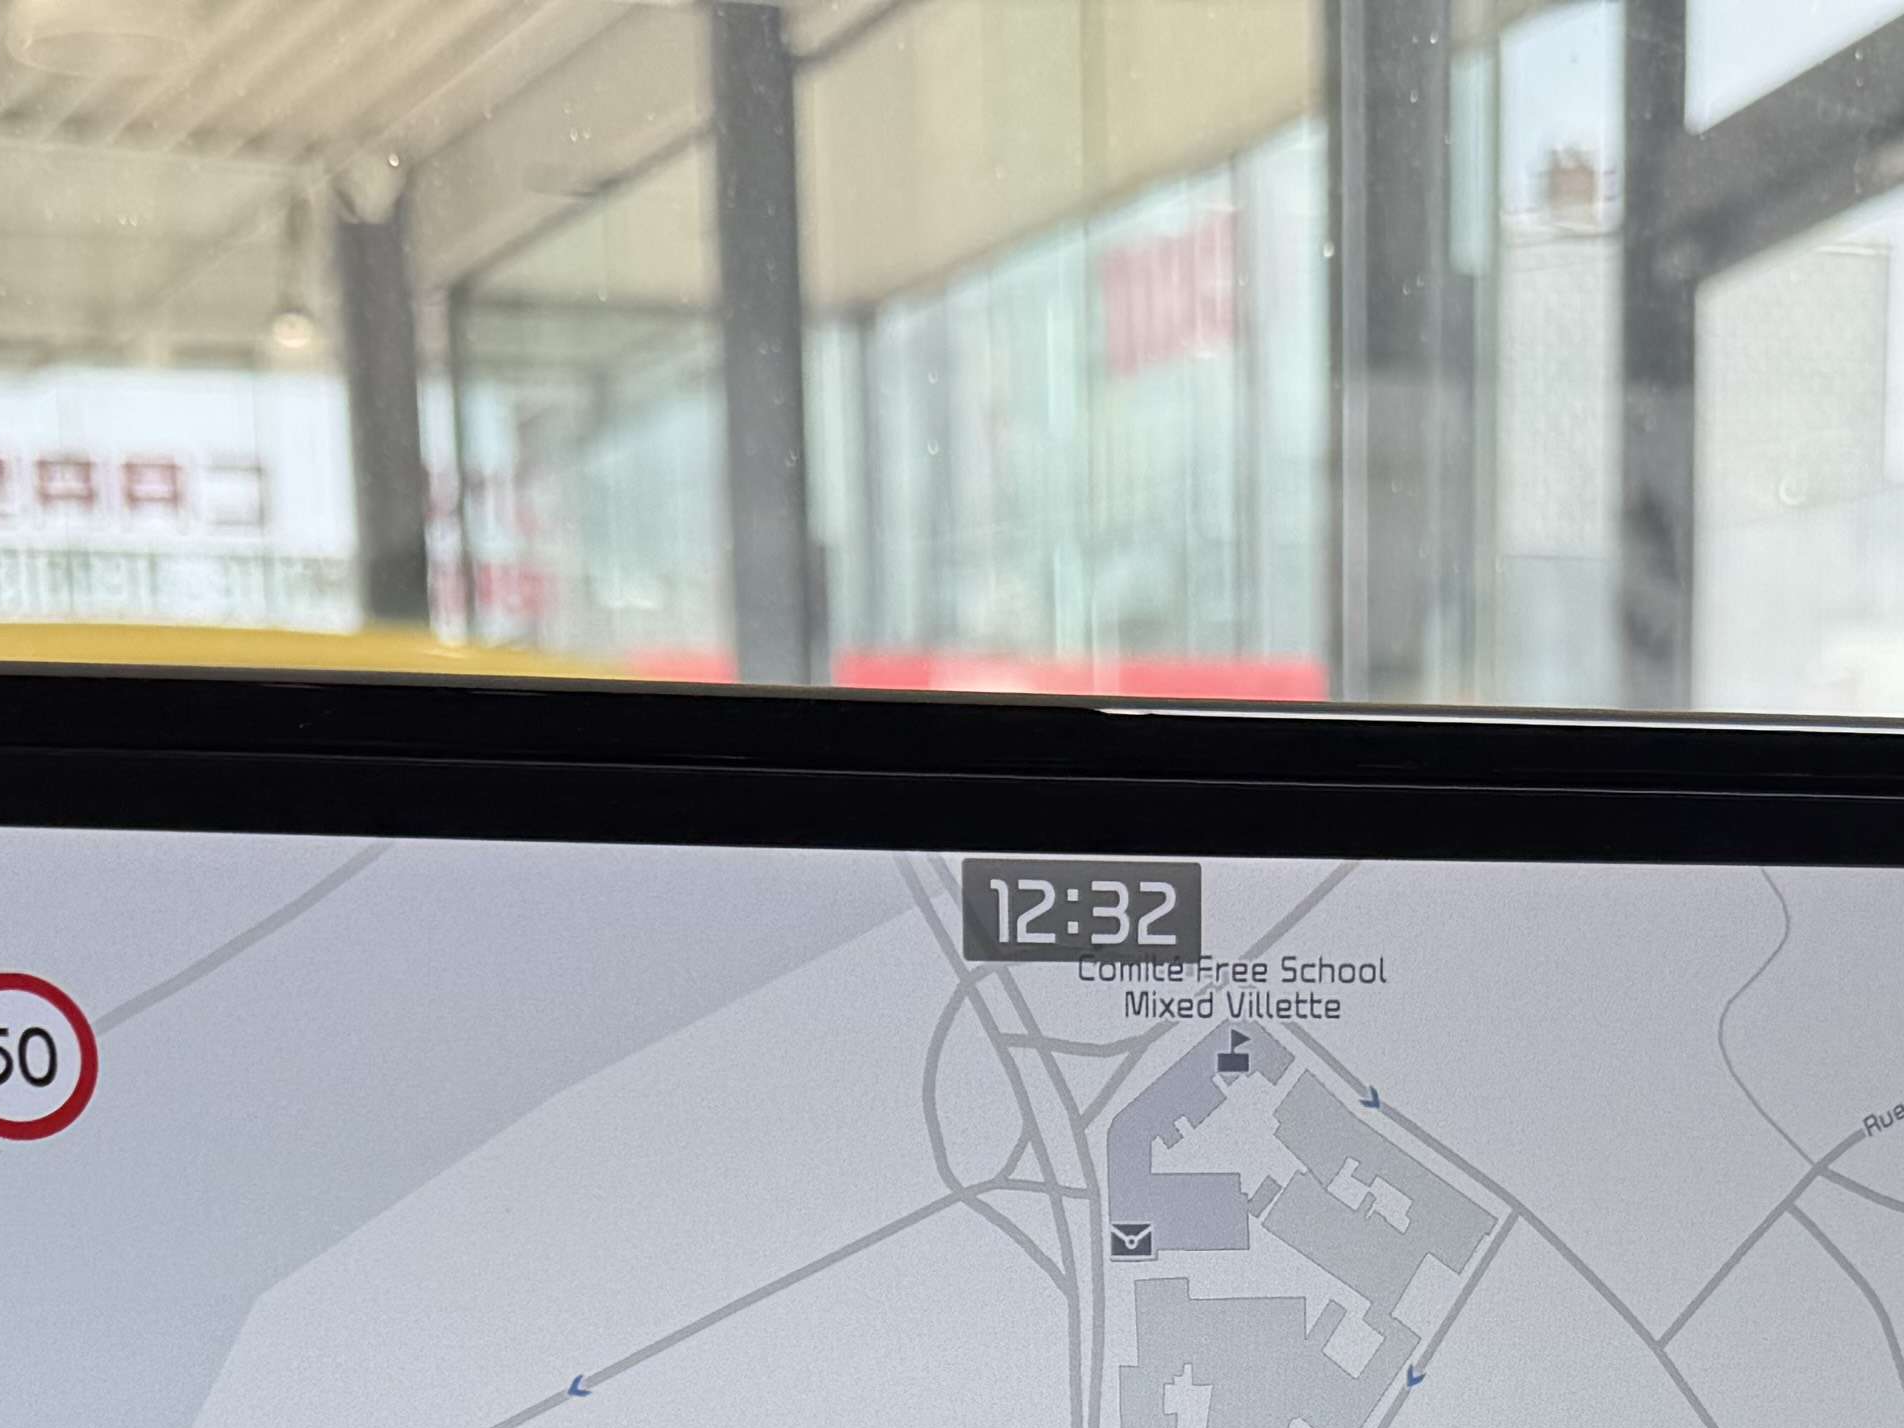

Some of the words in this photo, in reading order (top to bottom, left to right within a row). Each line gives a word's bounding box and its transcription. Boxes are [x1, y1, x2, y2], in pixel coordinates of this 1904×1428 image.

[989, 878, 1178, 945] 12:32
[1196, 955, 1268, 983] Free
[1281, 955, 1388, 984] School
[1124, 990, 1214, 1018] Mixed
[1226, 990, 1342, 1019] Villette
